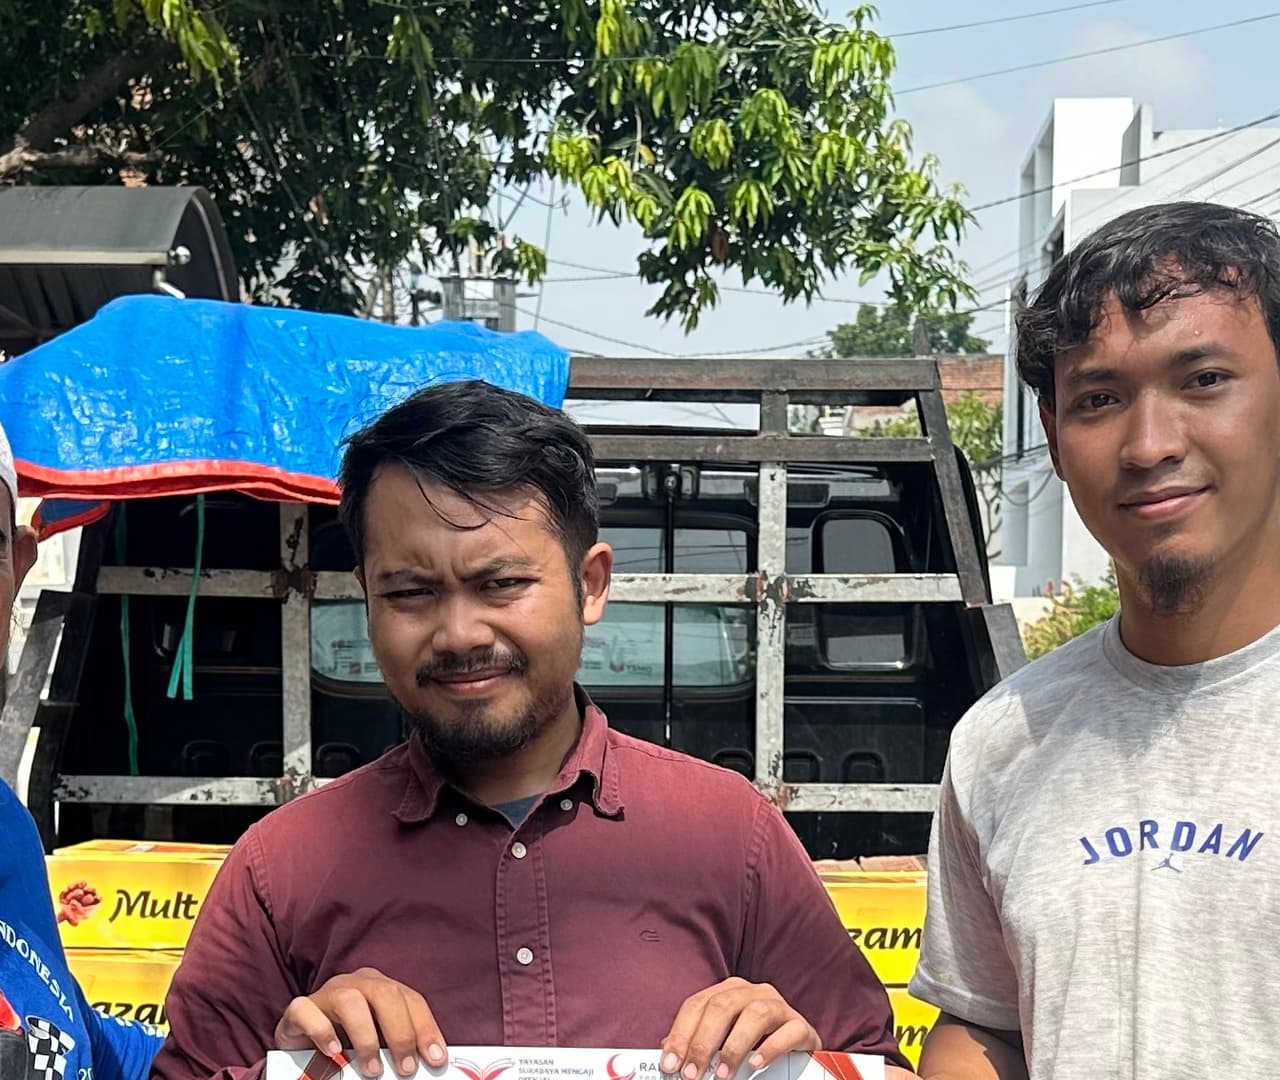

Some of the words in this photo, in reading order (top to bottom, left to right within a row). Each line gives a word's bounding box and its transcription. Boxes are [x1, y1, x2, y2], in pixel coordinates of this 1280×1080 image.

[1079, 819, 1265, 866] JORDAN
[108, 889, 199, 924] Mult
[518, 1067, 559, 1075] SURABAYA
[561, 1068, 594, 1076] MENGAJI
